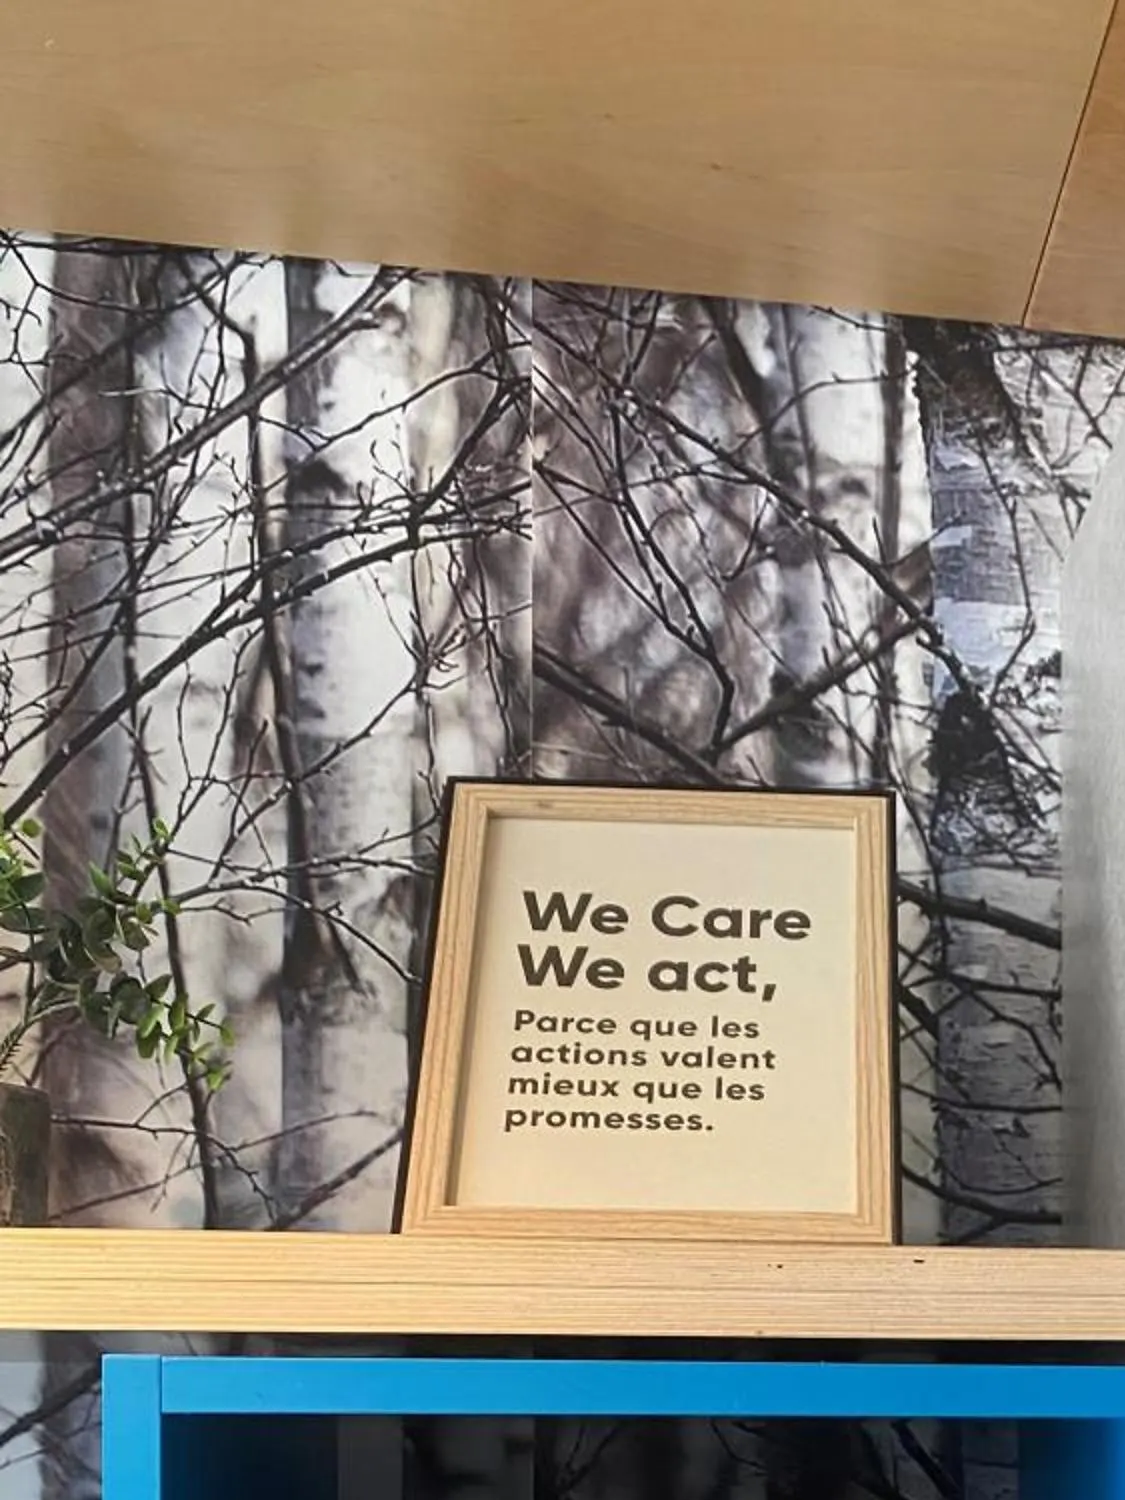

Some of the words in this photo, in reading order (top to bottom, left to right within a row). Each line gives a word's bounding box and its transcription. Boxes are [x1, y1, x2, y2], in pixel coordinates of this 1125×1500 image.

[523, 890, 629, 935] We
[651, 895, 812, 941] Care
[517, 943, 626, 990] We
[647, 955, 777, 1002] act,
[513, 1009, 617, 1035] Parce
[629, 1019, 698, 1042] que
[711, 1015, 760, 1039] les
[511, 1041, 647, 1067] actions
[660, 1045, 776, 1070] valent
[507, 1072, 619, 1097] mieux
[633, 1081, 702, 1104] que
[715, 1076, 765, 1101] les
[504, 1106, 714, 1133] promesses.
